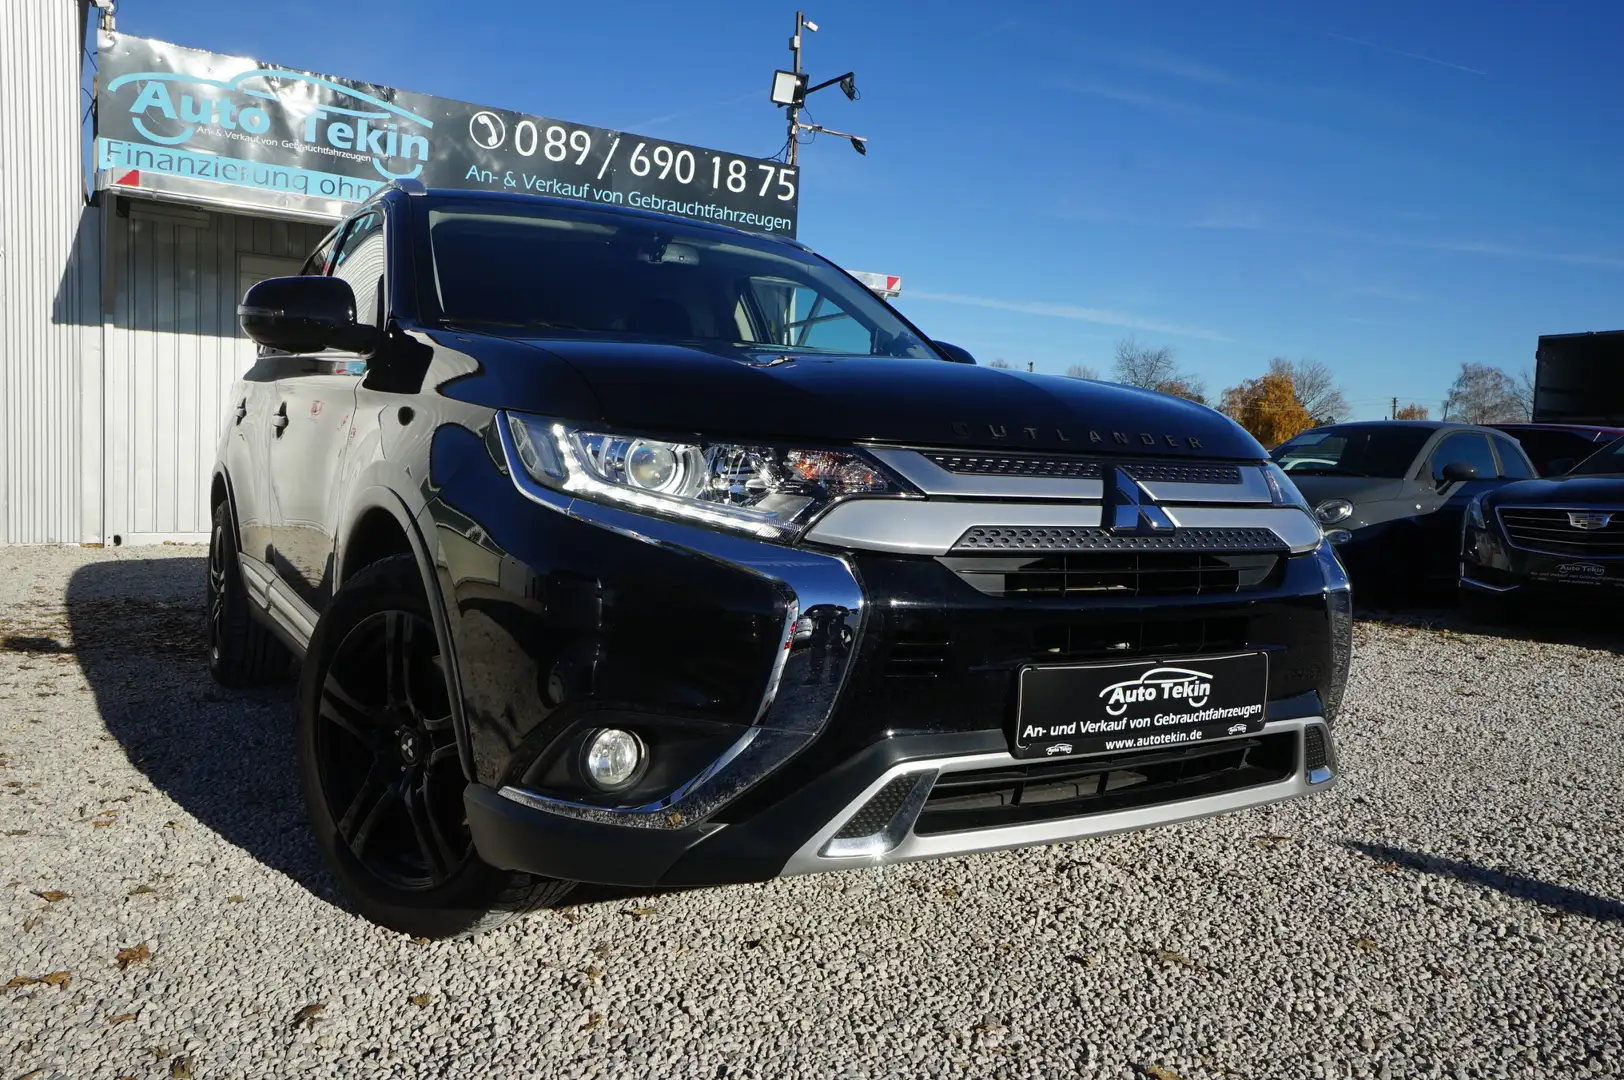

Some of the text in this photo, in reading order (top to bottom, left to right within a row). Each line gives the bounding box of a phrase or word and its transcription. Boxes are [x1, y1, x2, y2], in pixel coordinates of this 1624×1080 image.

[129, 81, 429, 161] Auto Tekin
[224, 130, 260, 145] Verkauf
[261, 136, 279, 147] von
[281, 139, 372, 164] Gebrauchtfahrzeugen
[514, 120, 592, 166] 089
[629, 142, 696, 185] 690
[712, 156, 747, 195] 18
[758, 164, 796, 202] 75
[106, 140, 375, 200] Finanzierung ohn
[465, 164, 793, 231] An- & Verkauf von Gebrauchtfahrzeugen
[951, 421, 1203, 449] OUTLANDER
[1108, 681, 1211, 705] Auto Tekin
[1023, 703, 1262, 738] An- und Verkauf von Gebrauchtfahrzeugen
[1105, 729, 1202, 751] www.autotekin.de
